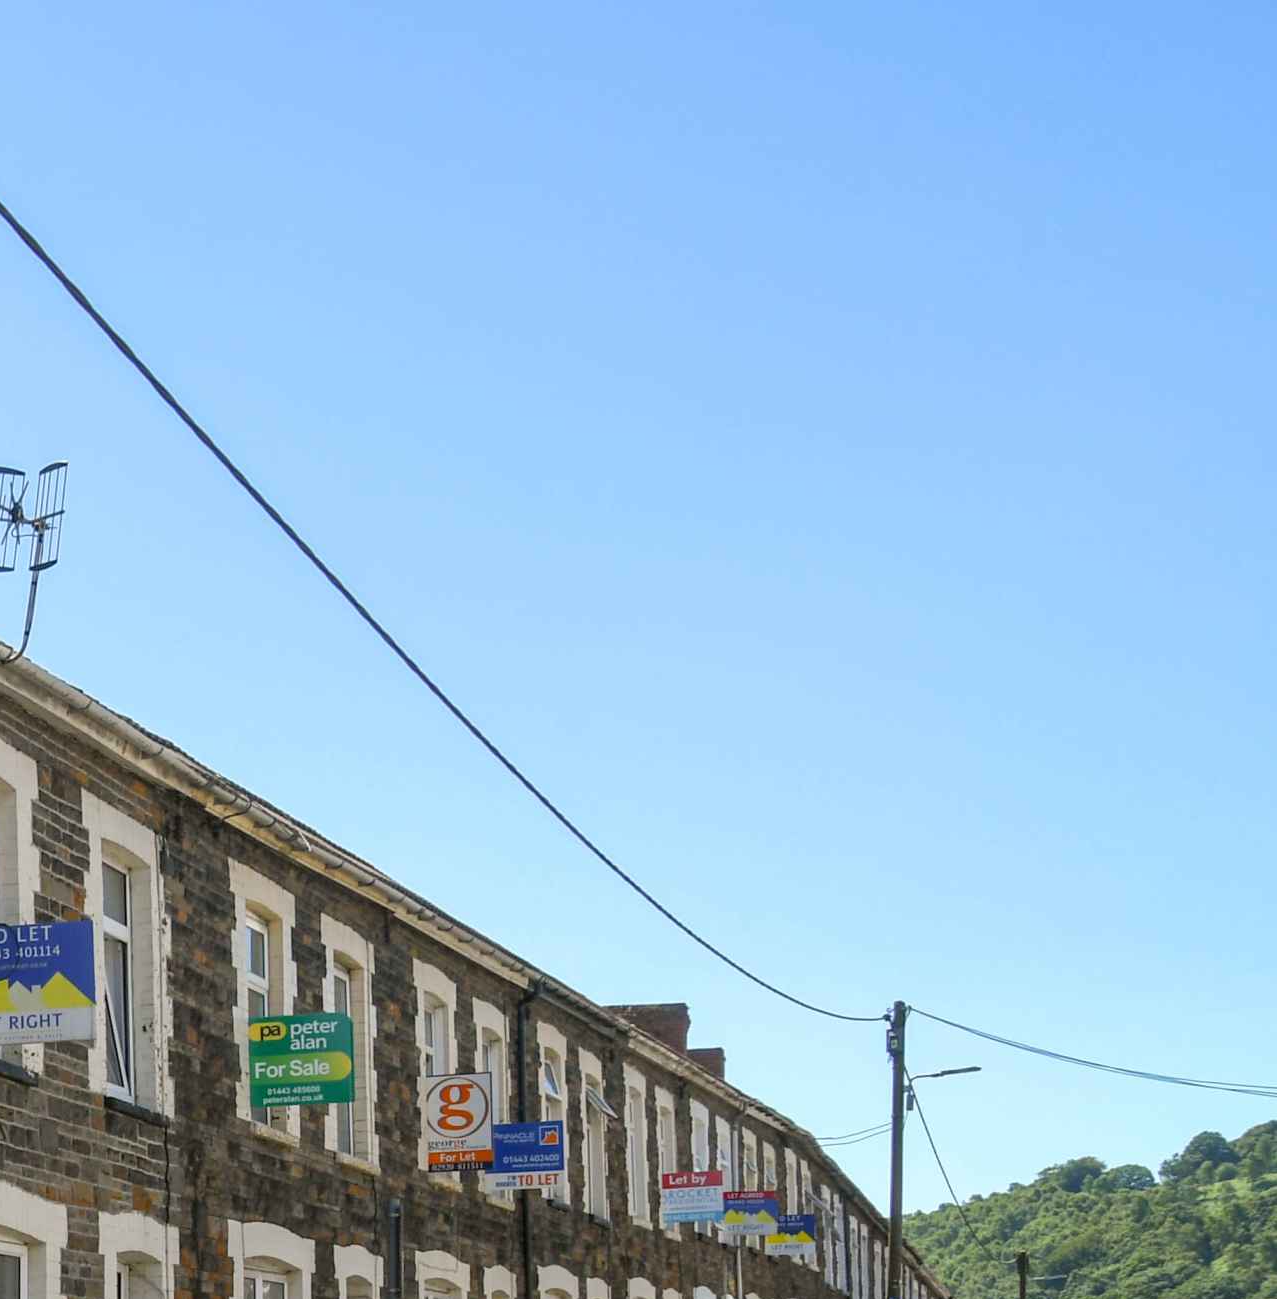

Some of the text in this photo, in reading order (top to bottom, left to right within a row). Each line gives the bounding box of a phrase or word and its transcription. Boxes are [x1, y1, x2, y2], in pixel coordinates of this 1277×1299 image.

[16, 925, 53, 943] LET
[15, 945, 61, 959] 401114
[9, 1013, 63, 1030] RIGHT
[260, 1020, 338, 1041] pa peter
[290, 1035, 327, 1050] alan
[254, 1059, 330, 1079] For Sale
[437, 1084, 476, 1131] g
[439, 1151, 476, 1163] For Let
[502, 1155, 528, 1164] 01443
[518, 1174, 534, 1186] TO
[538, 1173, 559, 1185] LET
[669, 1173, 707, 1186] Let by
